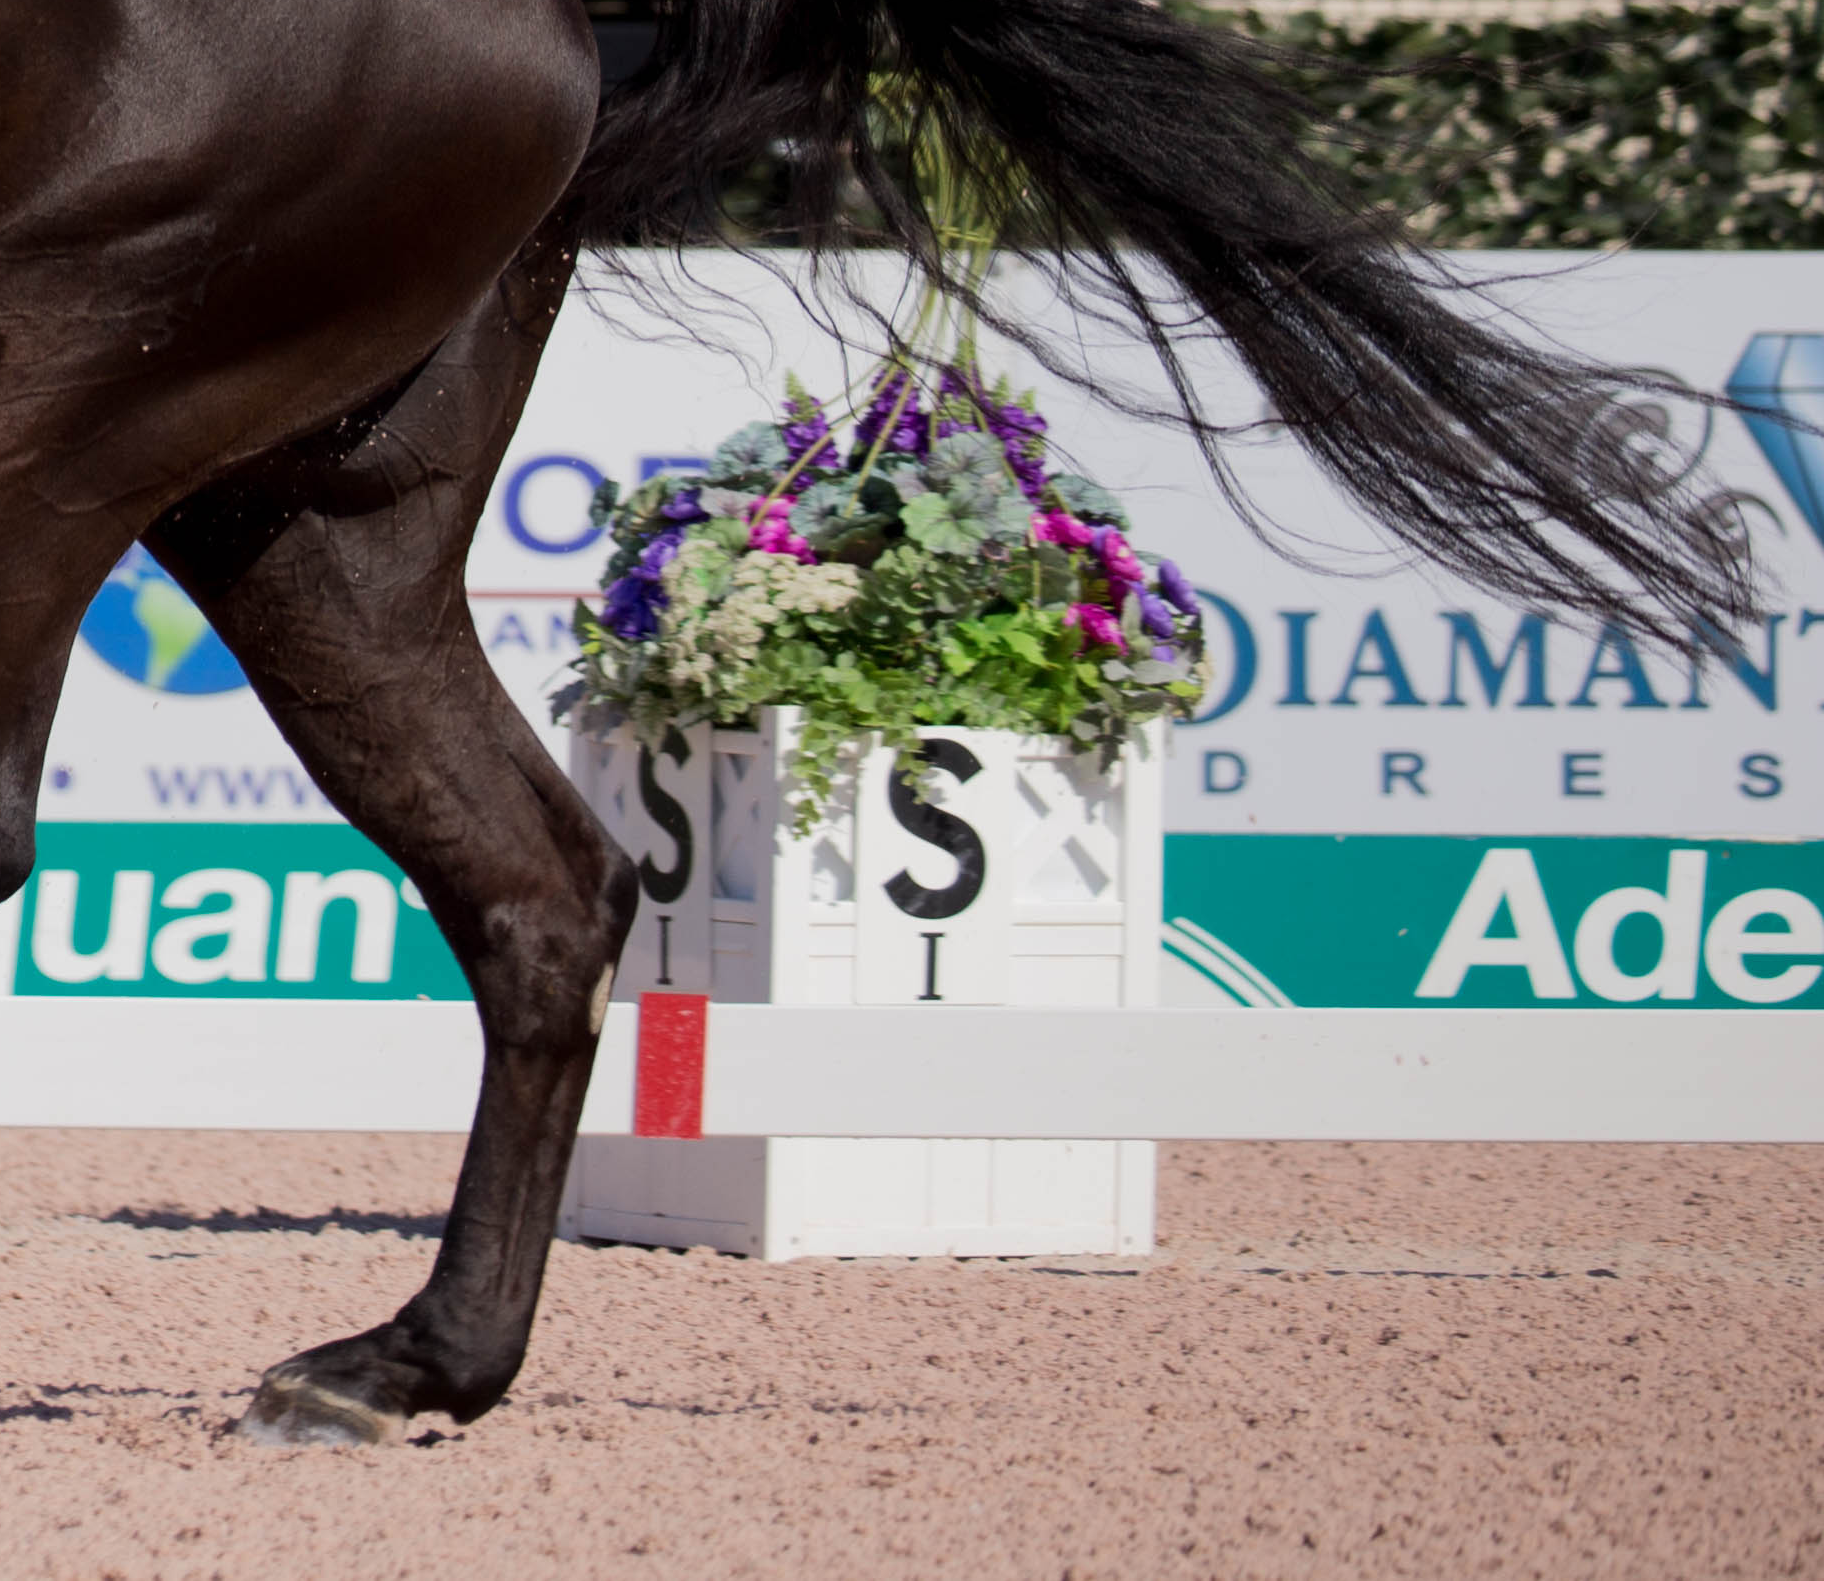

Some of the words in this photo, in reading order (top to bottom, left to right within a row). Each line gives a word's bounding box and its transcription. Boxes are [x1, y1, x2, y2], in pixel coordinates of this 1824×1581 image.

[881, 737, 986, 920] S
[655, 914, 674, 986] I
[916, 931, 947, 1002] I
